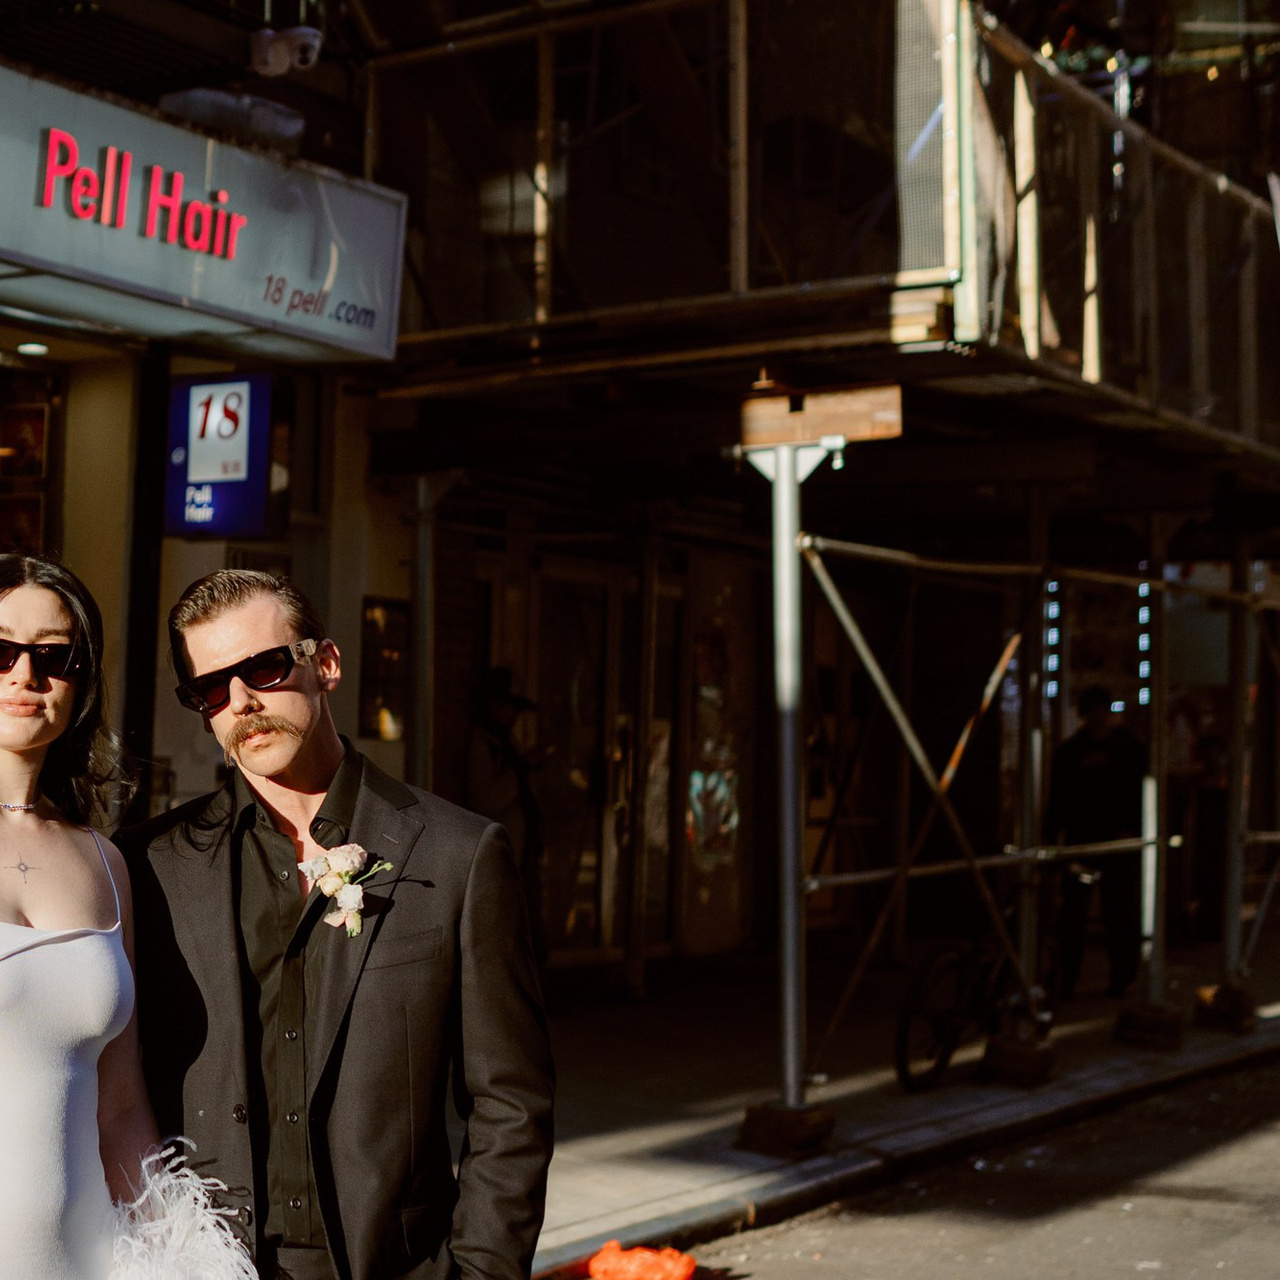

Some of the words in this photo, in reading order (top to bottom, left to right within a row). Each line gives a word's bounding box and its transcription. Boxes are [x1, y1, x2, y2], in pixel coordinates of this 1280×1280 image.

[40, 126, 133, 229] Pell
[143, 164, 248, 261] Hair
[197, 391, 243, 440] 18
